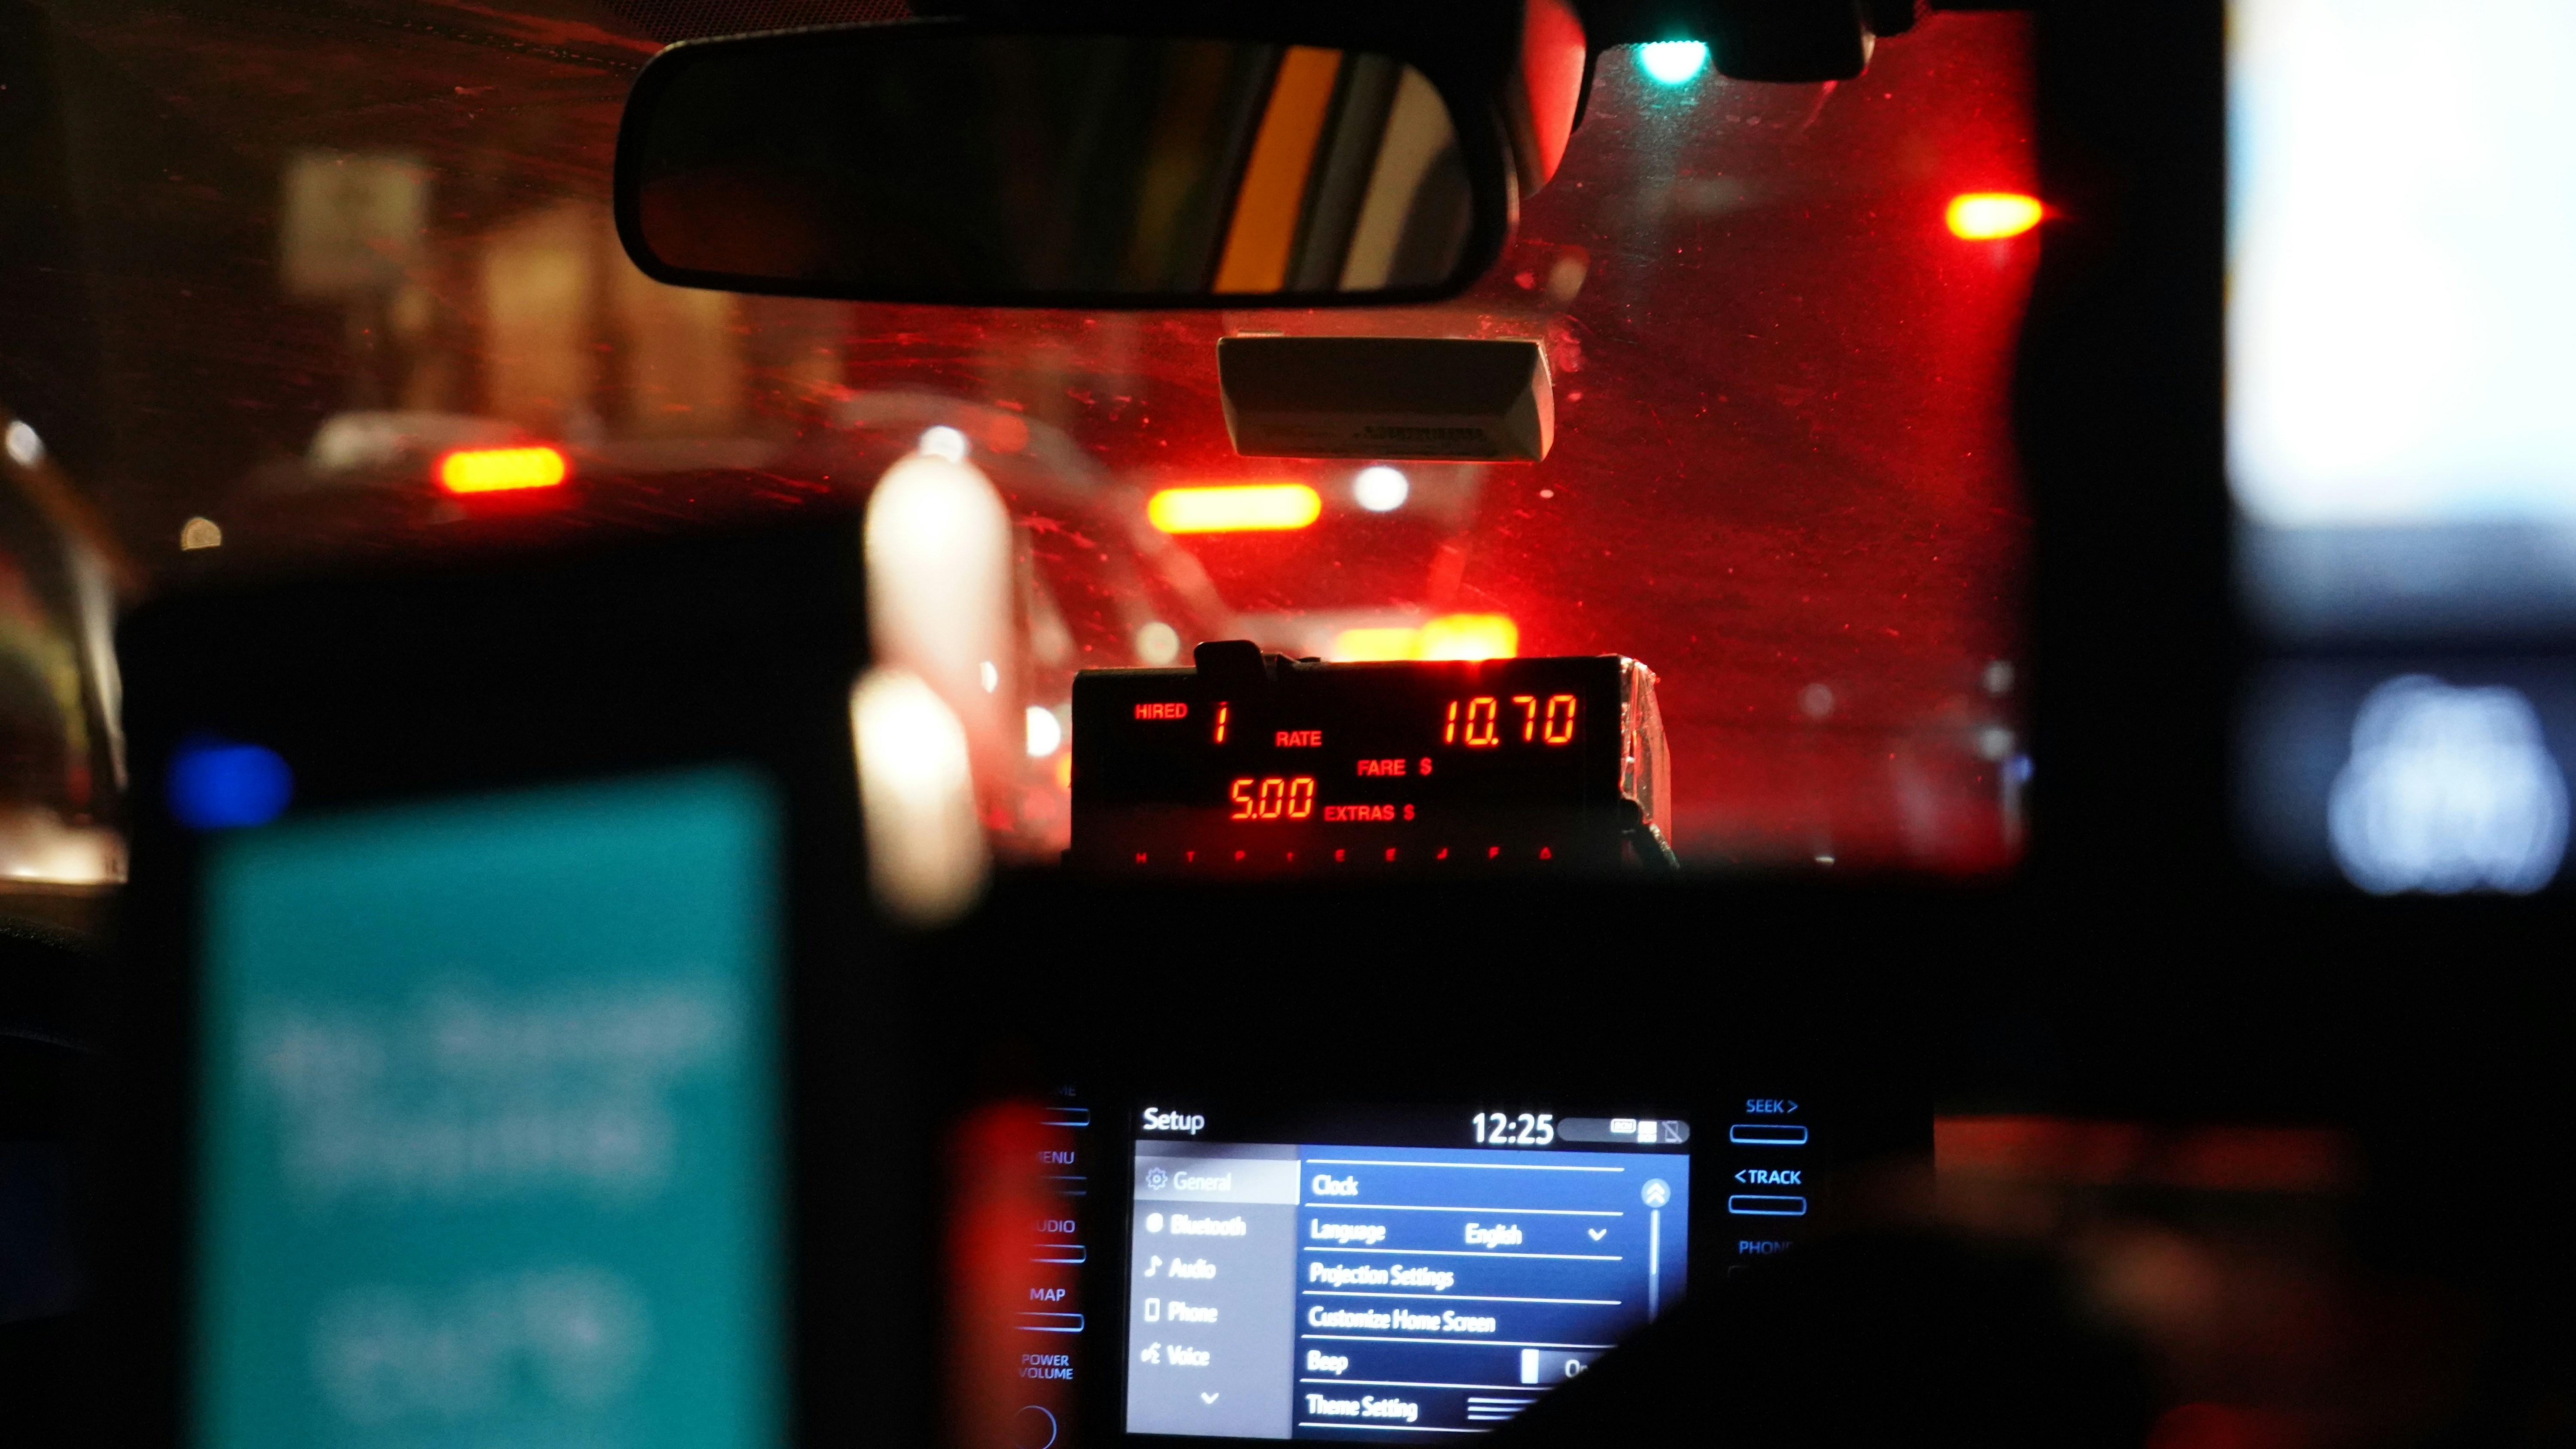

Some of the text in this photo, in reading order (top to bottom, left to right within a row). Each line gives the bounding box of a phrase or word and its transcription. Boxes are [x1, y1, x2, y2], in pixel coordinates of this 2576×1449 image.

[1135, 703, 1188, 719] HIRED
[1444, 694, 1577, 746] 10.70
[1215, 702, 1228, 743] 1
[1275, 731, 1322, 747] RATE
[1357, 757, 1432, 776] FARE $
[1230, 777, 1315, 819] 5.00
[1324, 804, 1415, 822] EXTRAS $
[1143, 1107, 1205, 1135] Setup
[1473, 1113, 1554, 1145] 12:25
[1173, 1171, 1231, 1191] General
[1312, 1174, 1358, 1196] Clock
[1036, 1220, 1075, 1233] UDIO
[1170, 1214, 1247, 1236] Bluetooth
[1311, 1218, 1522, 1248] Language English
[1168, 1257, 1217, 1279] Audio
[1309, 1262, 1454, 1291] Projection Settings
[1030, 1288, 1066, 1302] MAP
[1168, 1300, 1218, 1322] Phone
[1309, 1306, 1496, 1333] Customize Home Screen
[1022, 1354, 1069, 1366] POWER
[1166, 1344, 1211, 1366] Voice
[1306, 1349, 1349, 1375] Beep
[1019, 1367, 1074, 1380] VOLUME
[1305, 1393, 1419, 1422] Theme Setting
